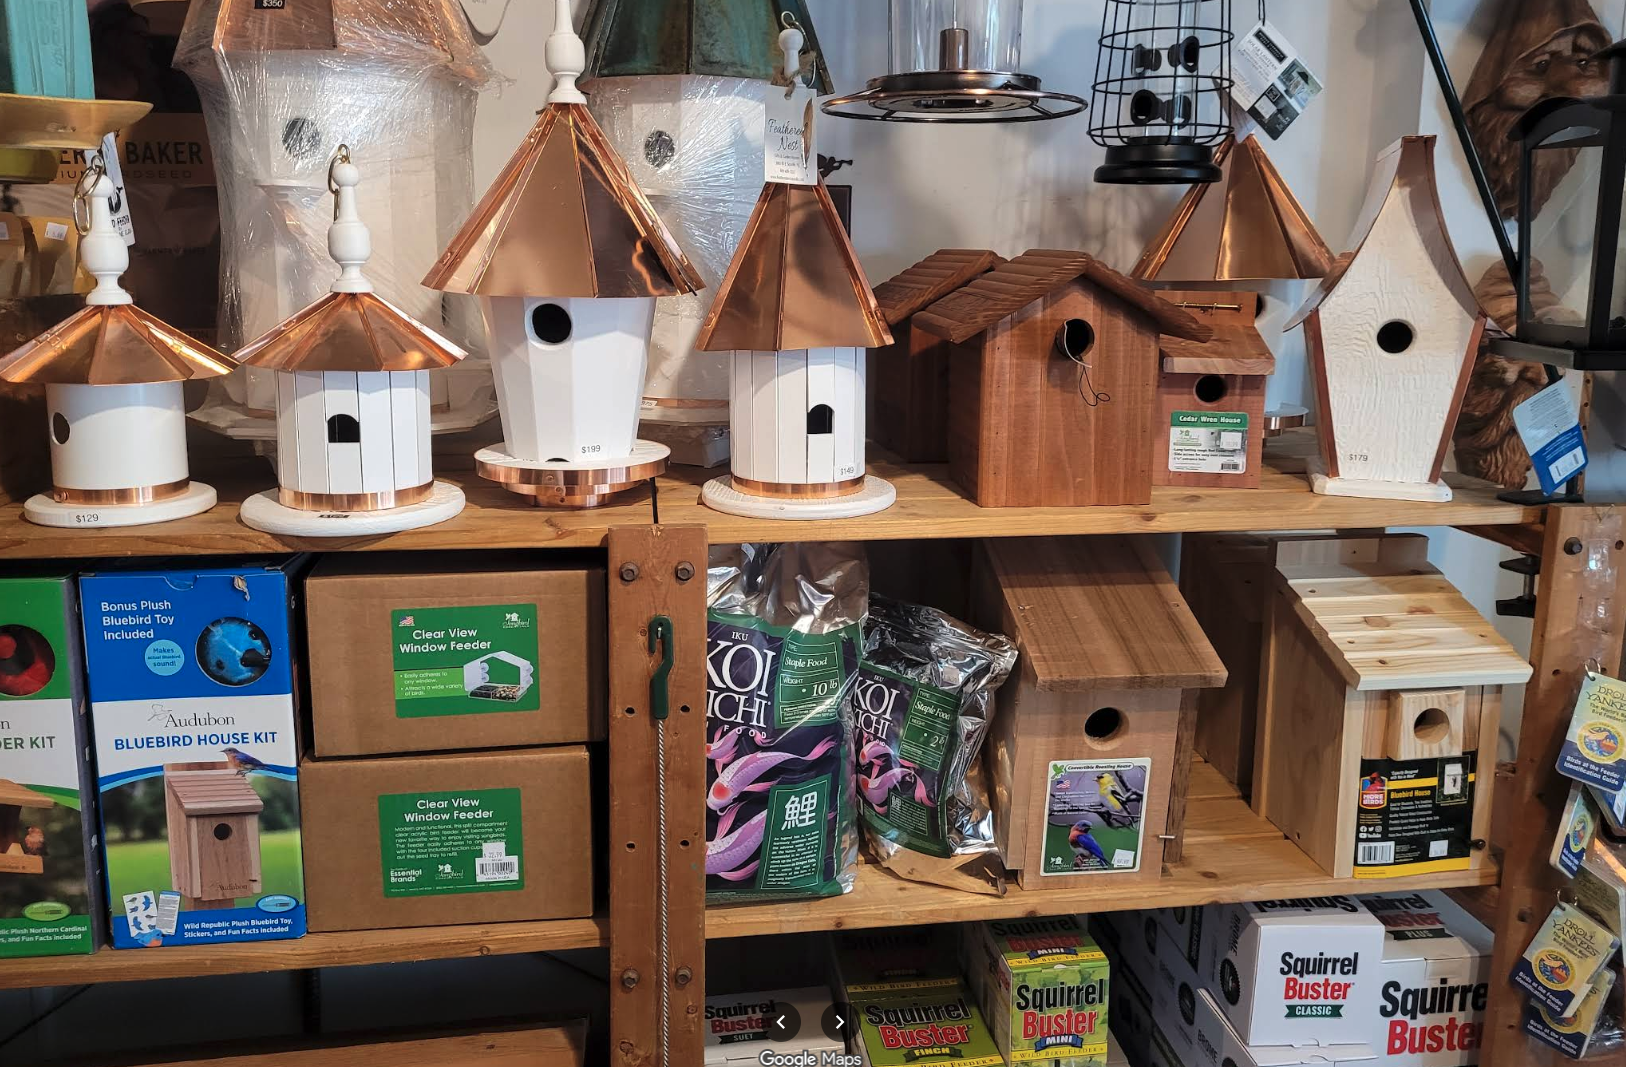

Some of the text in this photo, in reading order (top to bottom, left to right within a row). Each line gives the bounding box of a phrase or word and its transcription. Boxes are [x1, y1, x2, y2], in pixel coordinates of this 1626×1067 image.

[777, 136, 799, 151] Nest
[125, 141, 204, 165] BAKER
[1179, 415, 1198, 423] Cedar
[1220, 416, 1242, 424] House
[581, 444, 601, 454] $199
[1348, 453, 1368, 462] $179
[75, 513, 99, 523] $129
[101, 600, 172, 612] Bonus Plush
[102, 614, 175, 626] Bluebird Toy
[103, 629, 154, 640] Included
[412, 628, 478, 640] Clear View
[731, 631, 749, 641] IKU
[399, 640, 492, 654] Window Feeder
[707, 637, 777, 698] KOI
[784, 656, 828, 669] Staple Food
[811, 680, 838, 697] 10 lb
[853, 676, 900, 721] KOI
[914, 700, 935, 715] Staple
[164, 712, 236, 728] Audubon
[29, 736, 56, 749] KIT
[114, 731, 278, 751] BLUEBIRD HOUSE KIT
[929, 735, 939, 748] 2
[1563, 761, 1619, 786] Identification Guide
[1566, 755, 1582, 765] Birds
[1589, 764, 1600, 772] the
[1600, 768, 1620, 779] Feeder
[1390, 789, 1431, 799] Bluebird House
[416, 798, 480, 809] Clear View
[404, 809, 494, 822] Window Feeder
[780, 790, 818, 831] 鯉
[390, 869, 422, 877] Essential
[29, 926, 60, 934] Northern
[60, 925, 88, 933] Cardinal
[184, 917, 293, 930] Wild Republic Plush Bluebird Toy,
[34, 934, 53, 942] Facts
[184, 930, 213, 938] Stickers,
[241, 927, 260, 935] Facts
[1404, 929, 1433, 939] PLUS
[1552, 919, 1600, 957] YANKEES
[1563, 918, 1596, 945] DROLL
[1037, 947, 1066, 955] MINI
[1279, 951, 1359, 978] Squirrel
[1016, 978, 1105, 1012] Squirrel
[1283, 977, 1351, 1001] Buster
[1379, 977, 1488, 1020] Squirre
[705, 1000, 778, 1022] Squirrel
[864, 998, 972, 1028] Squirrel
[1295, 1004, 1333, 1016] CLASSIC
[710, 1015, 778, 1034] Buster
[1022, 1008, 1098, 1040] Buster
[733, 1033, 754, 1042] SUET
[878, 1024, 970, 1049] Buster
[1045, 1034, 1073, 1045] MINI
[1386, 1017, 1483, 1056] Buste
[914, 1047, 951, 1056] FINCH
